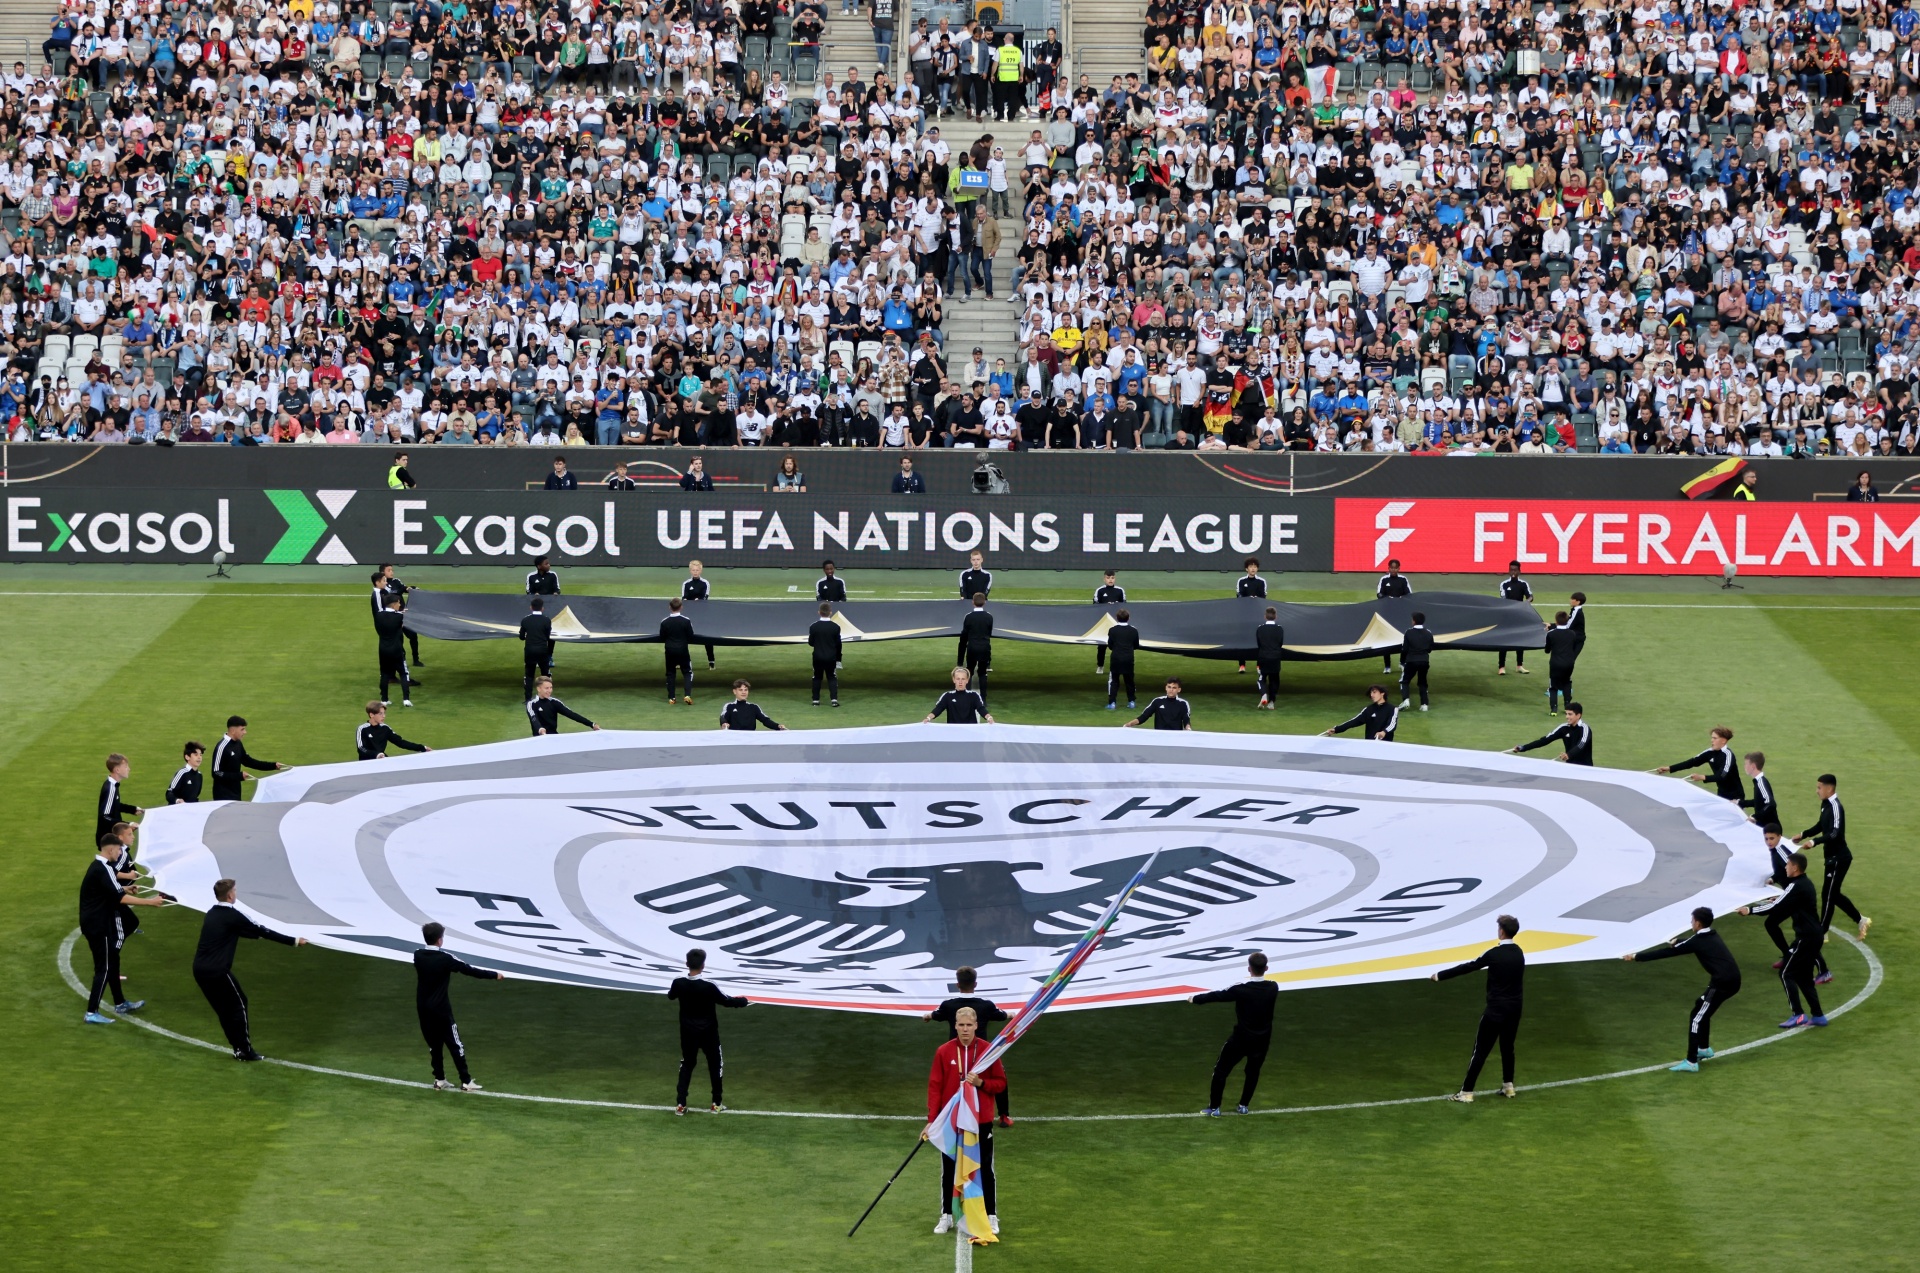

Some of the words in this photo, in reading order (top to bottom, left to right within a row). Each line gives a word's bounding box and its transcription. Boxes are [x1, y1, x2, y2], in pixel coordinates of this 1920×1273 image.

[966, 175, 983, 183] EIS
[7, 497, 235, 553] Exasol
[393, 500, 621, 556] Exasol
[657, 509, 795, 550] UEFA
[813, 511, 1060, 553] NATIONS
[1082, 513, 1299, 555] LEAGUE
[1474, 511, 1920, 567] FLYERALARM
[566, 795, 1360, 832] DEUTSCHER
